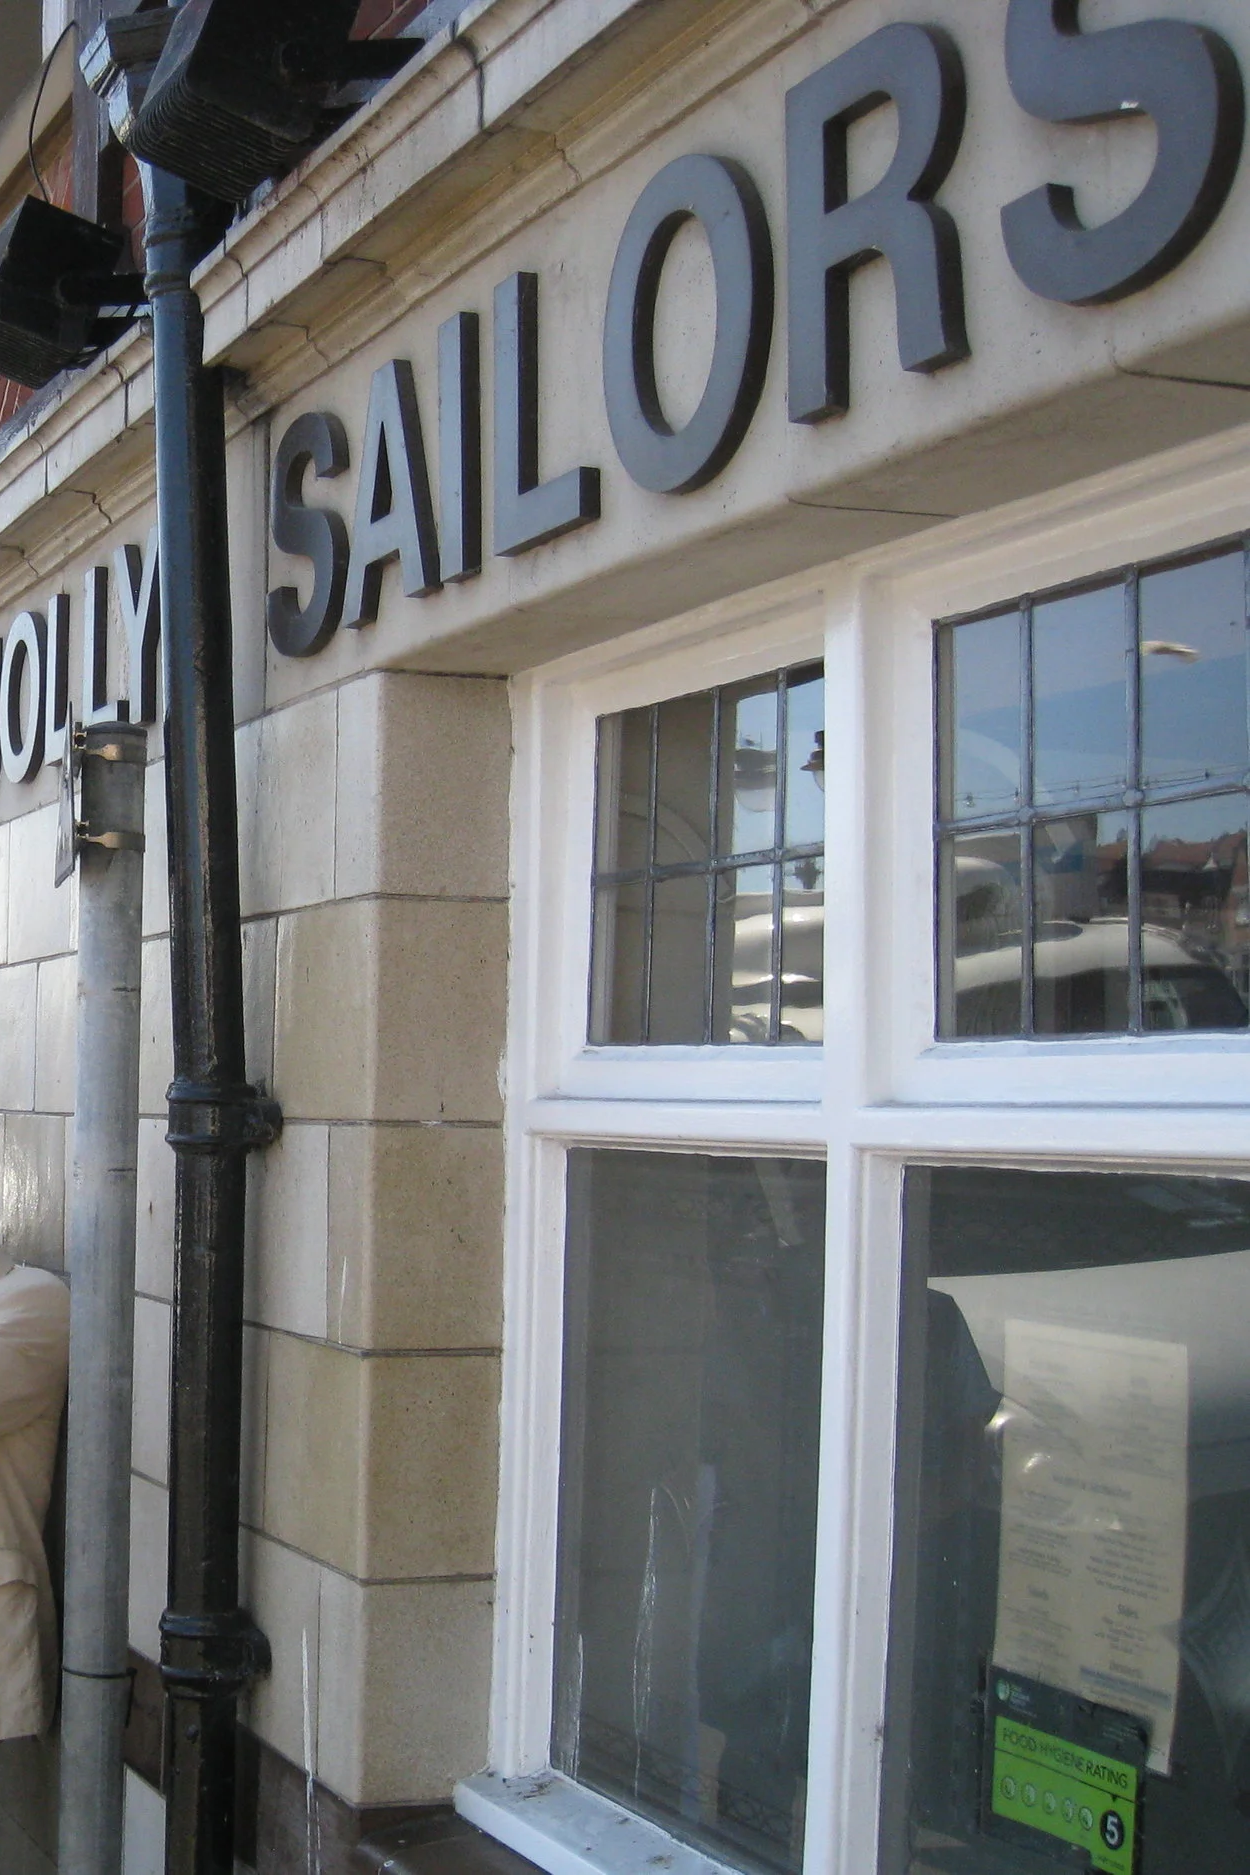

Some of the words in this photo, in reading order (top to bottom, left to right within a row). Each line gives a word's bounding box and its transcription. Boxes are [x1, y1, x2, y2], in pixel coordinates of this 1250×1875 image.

[267, 0, 1247, 657] SAILORS
[1002, 1727, 1037, 1752] FOOD
[1085, 1760, 1128, 1789] RATING
[1105, 1815, 1120, 1845] 5
